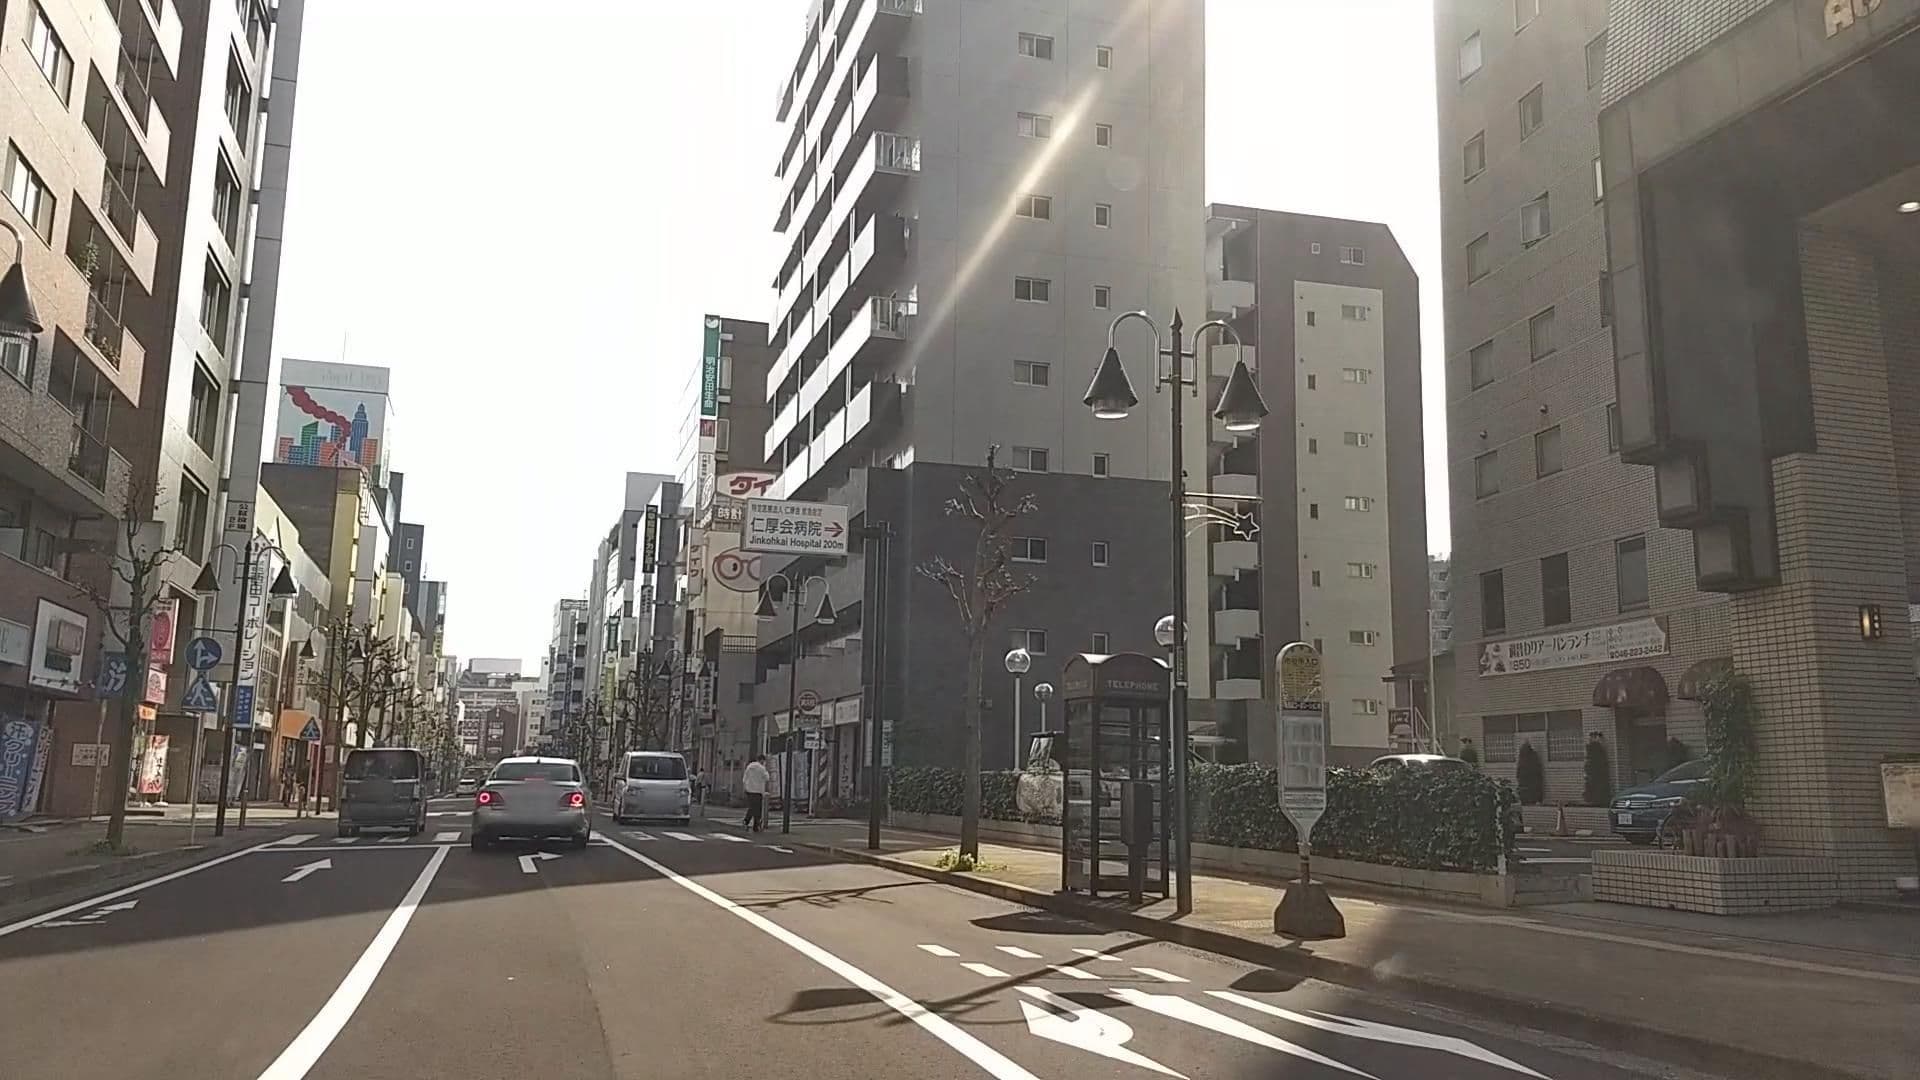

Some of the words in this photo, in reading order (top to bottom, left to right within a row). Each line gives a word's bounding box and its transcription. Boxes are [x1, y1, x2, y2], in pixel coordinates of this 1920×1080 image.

[750, 517, 822, 537] 仁厚会病院
[749, 535, 788, 546] Jinkohkai
[790, 538, 822, 550] Hospital
[823, 540, 844, 550] 200m
[1106, 679, 1161, 691] TELEPHONE
